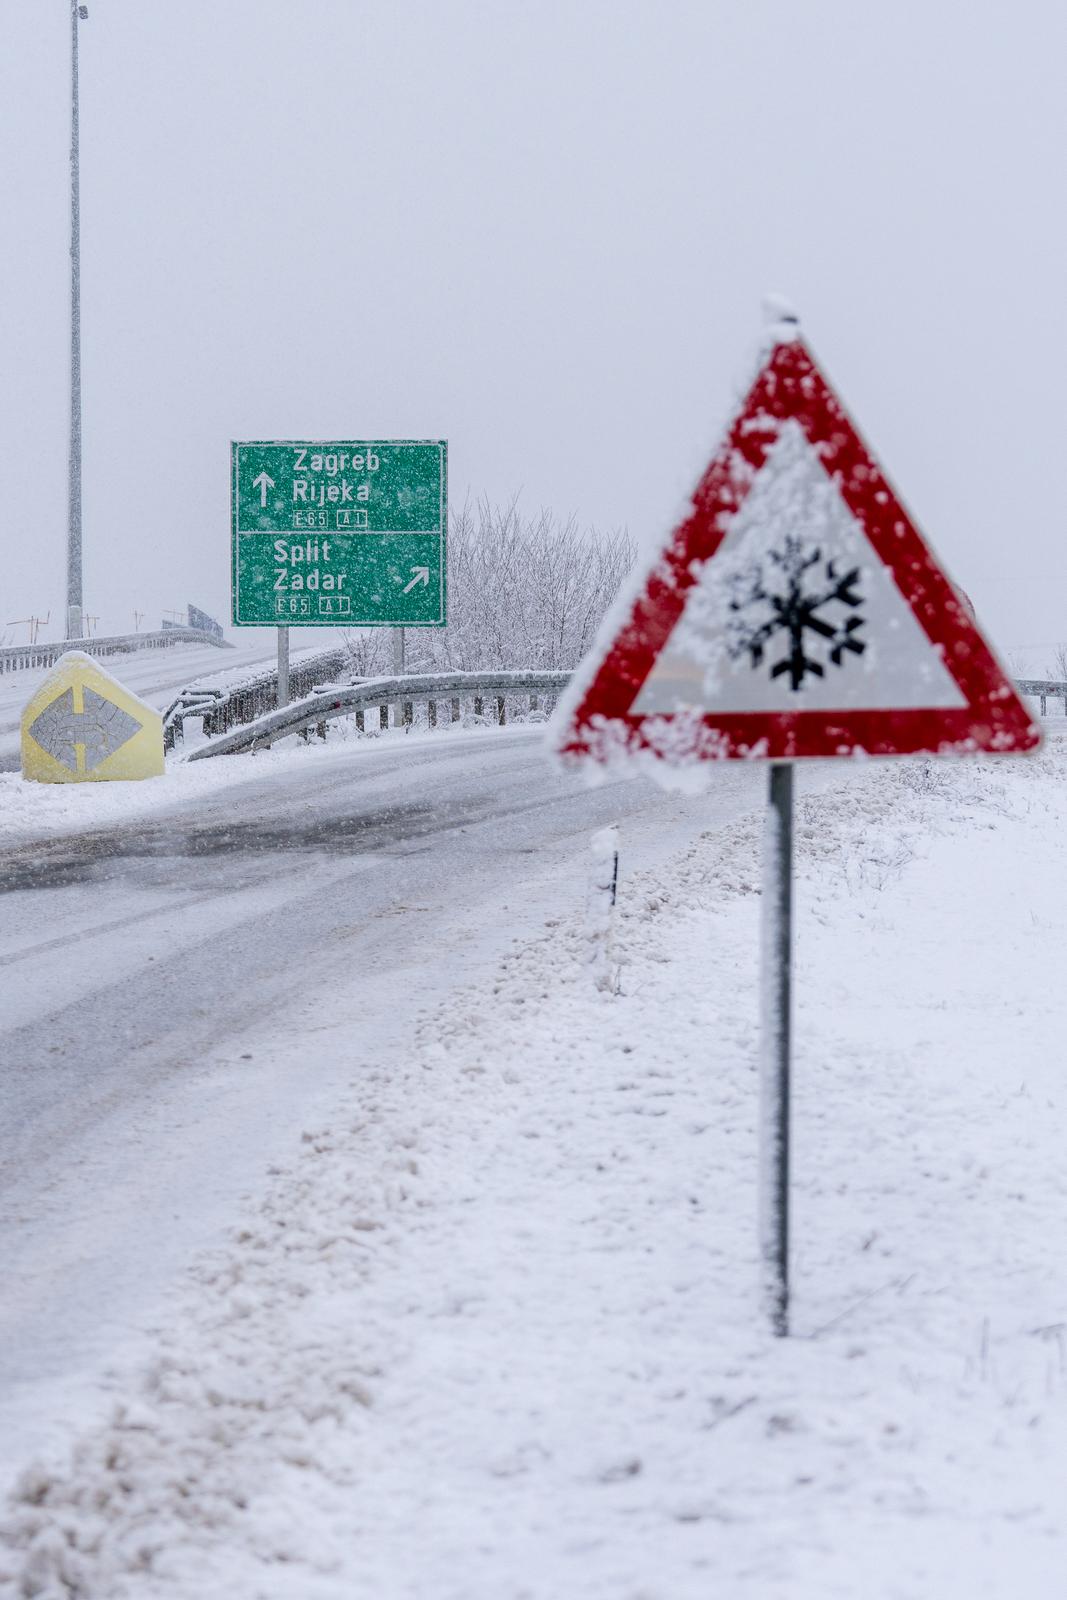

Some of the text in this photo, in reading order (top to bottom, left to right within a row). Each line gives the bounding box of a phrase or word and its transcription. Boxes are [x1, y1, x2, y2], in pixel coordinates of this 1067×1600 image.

[293, 449, 380, 477] Zagreb
[293, 479, 369, 507] Rijeka
[273, 539, 332, 567] Split
[273, 568, 347, 590] Zadar
